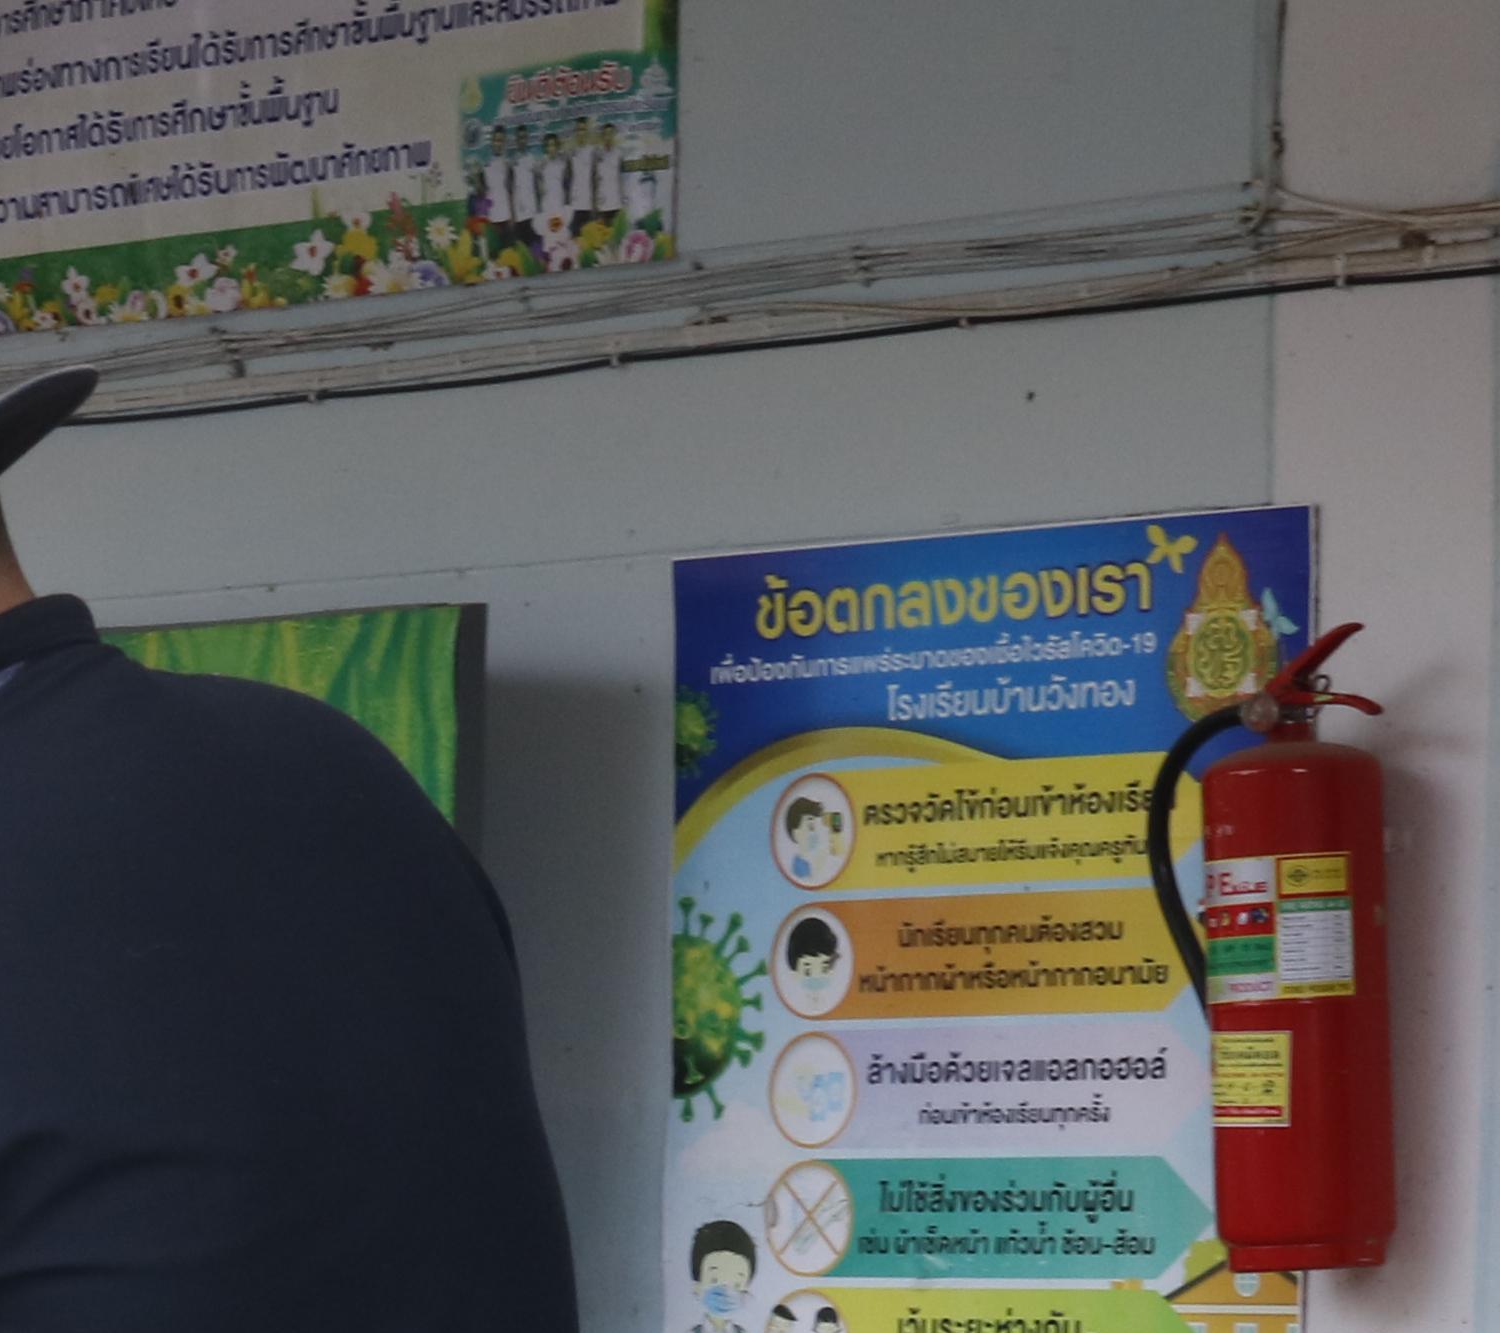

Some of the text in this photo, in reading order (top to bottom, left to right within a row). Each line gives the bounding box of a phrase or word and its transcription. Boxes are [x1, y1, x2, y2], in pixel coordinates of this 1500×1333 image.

[755, 562, 1151, 639] ข้อตกลงของเรา
[887, 676, 1136, 722] โรงเรียนบ้านวังทอง
[898, 915, 1124, 955] นักเรียนทุกคนต้องสวม
[867, 1046, 1169, 1085] ล้างมือด้วยเจลแอลกอฮอล์
[878, 1170, 1136, 1223] ไม่ใช้สิ่งของร่วมกับผู้อื่น
